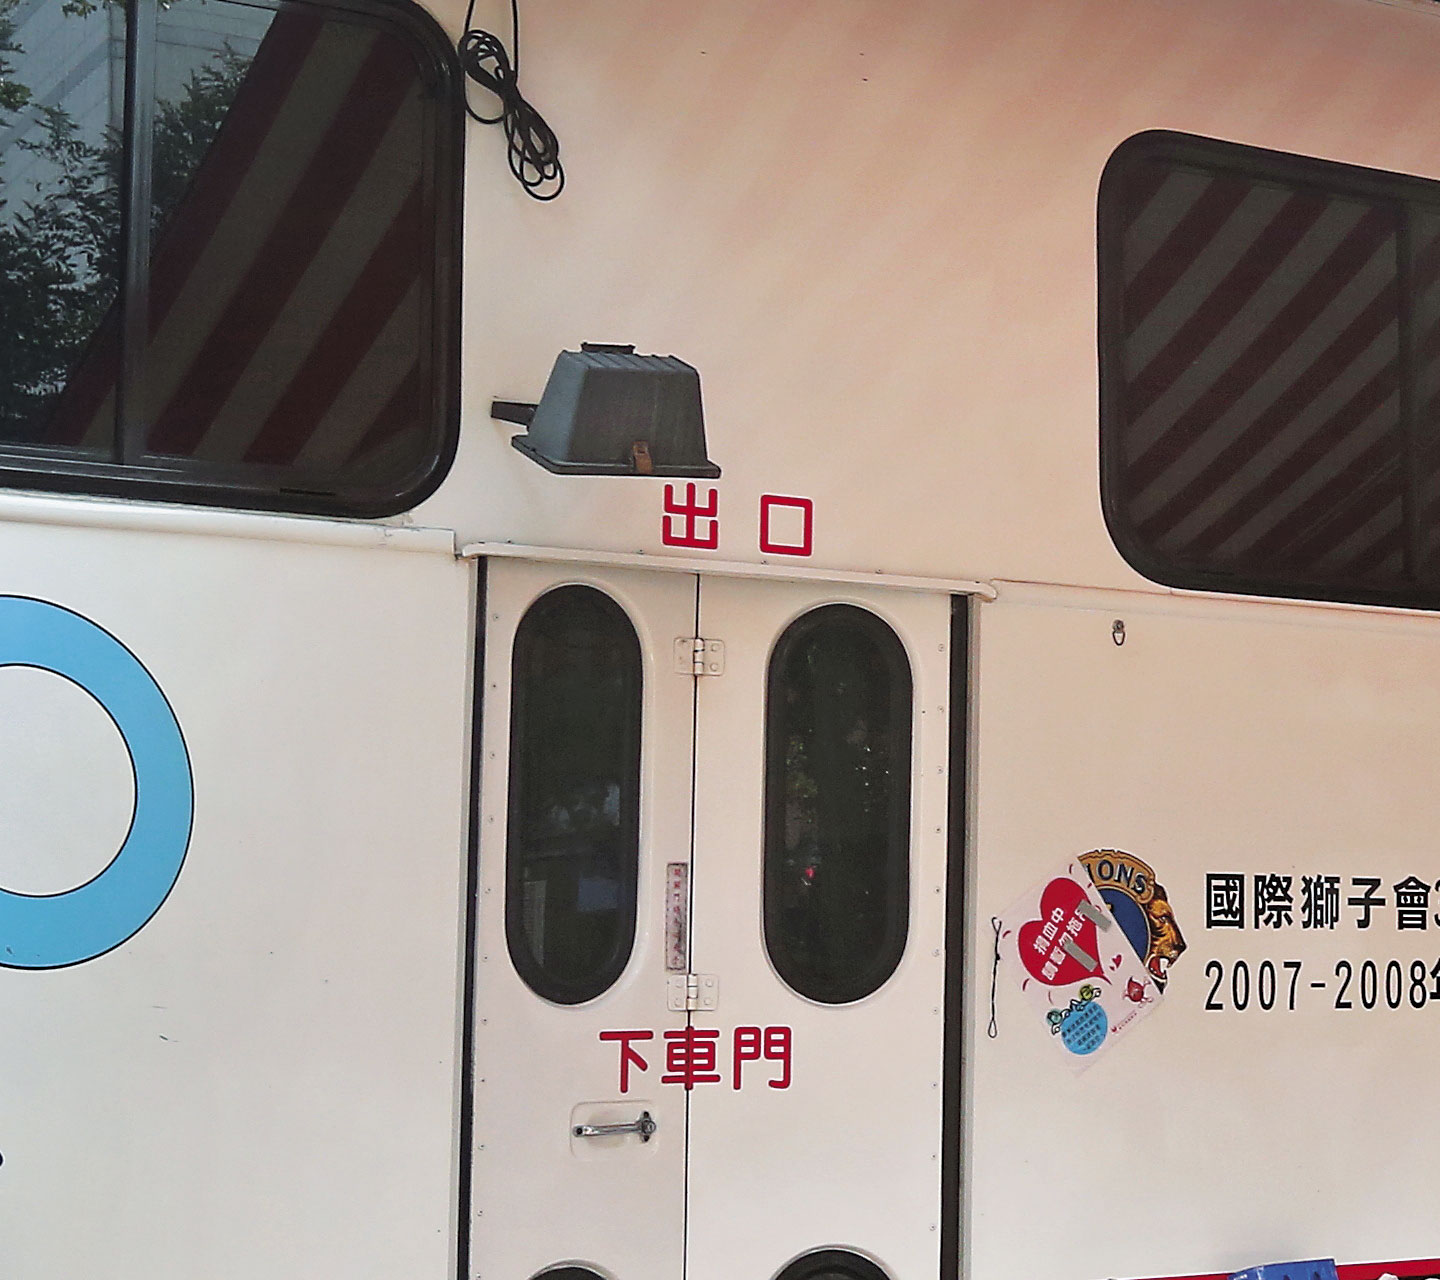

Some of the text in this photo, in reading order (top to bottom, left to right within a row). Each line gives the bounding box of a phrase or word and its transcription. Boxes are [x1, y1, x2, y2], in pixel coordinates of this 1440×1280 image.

[662, 483, 814, 556] 出口
[599, 1026, 792, 1092] 下車門
